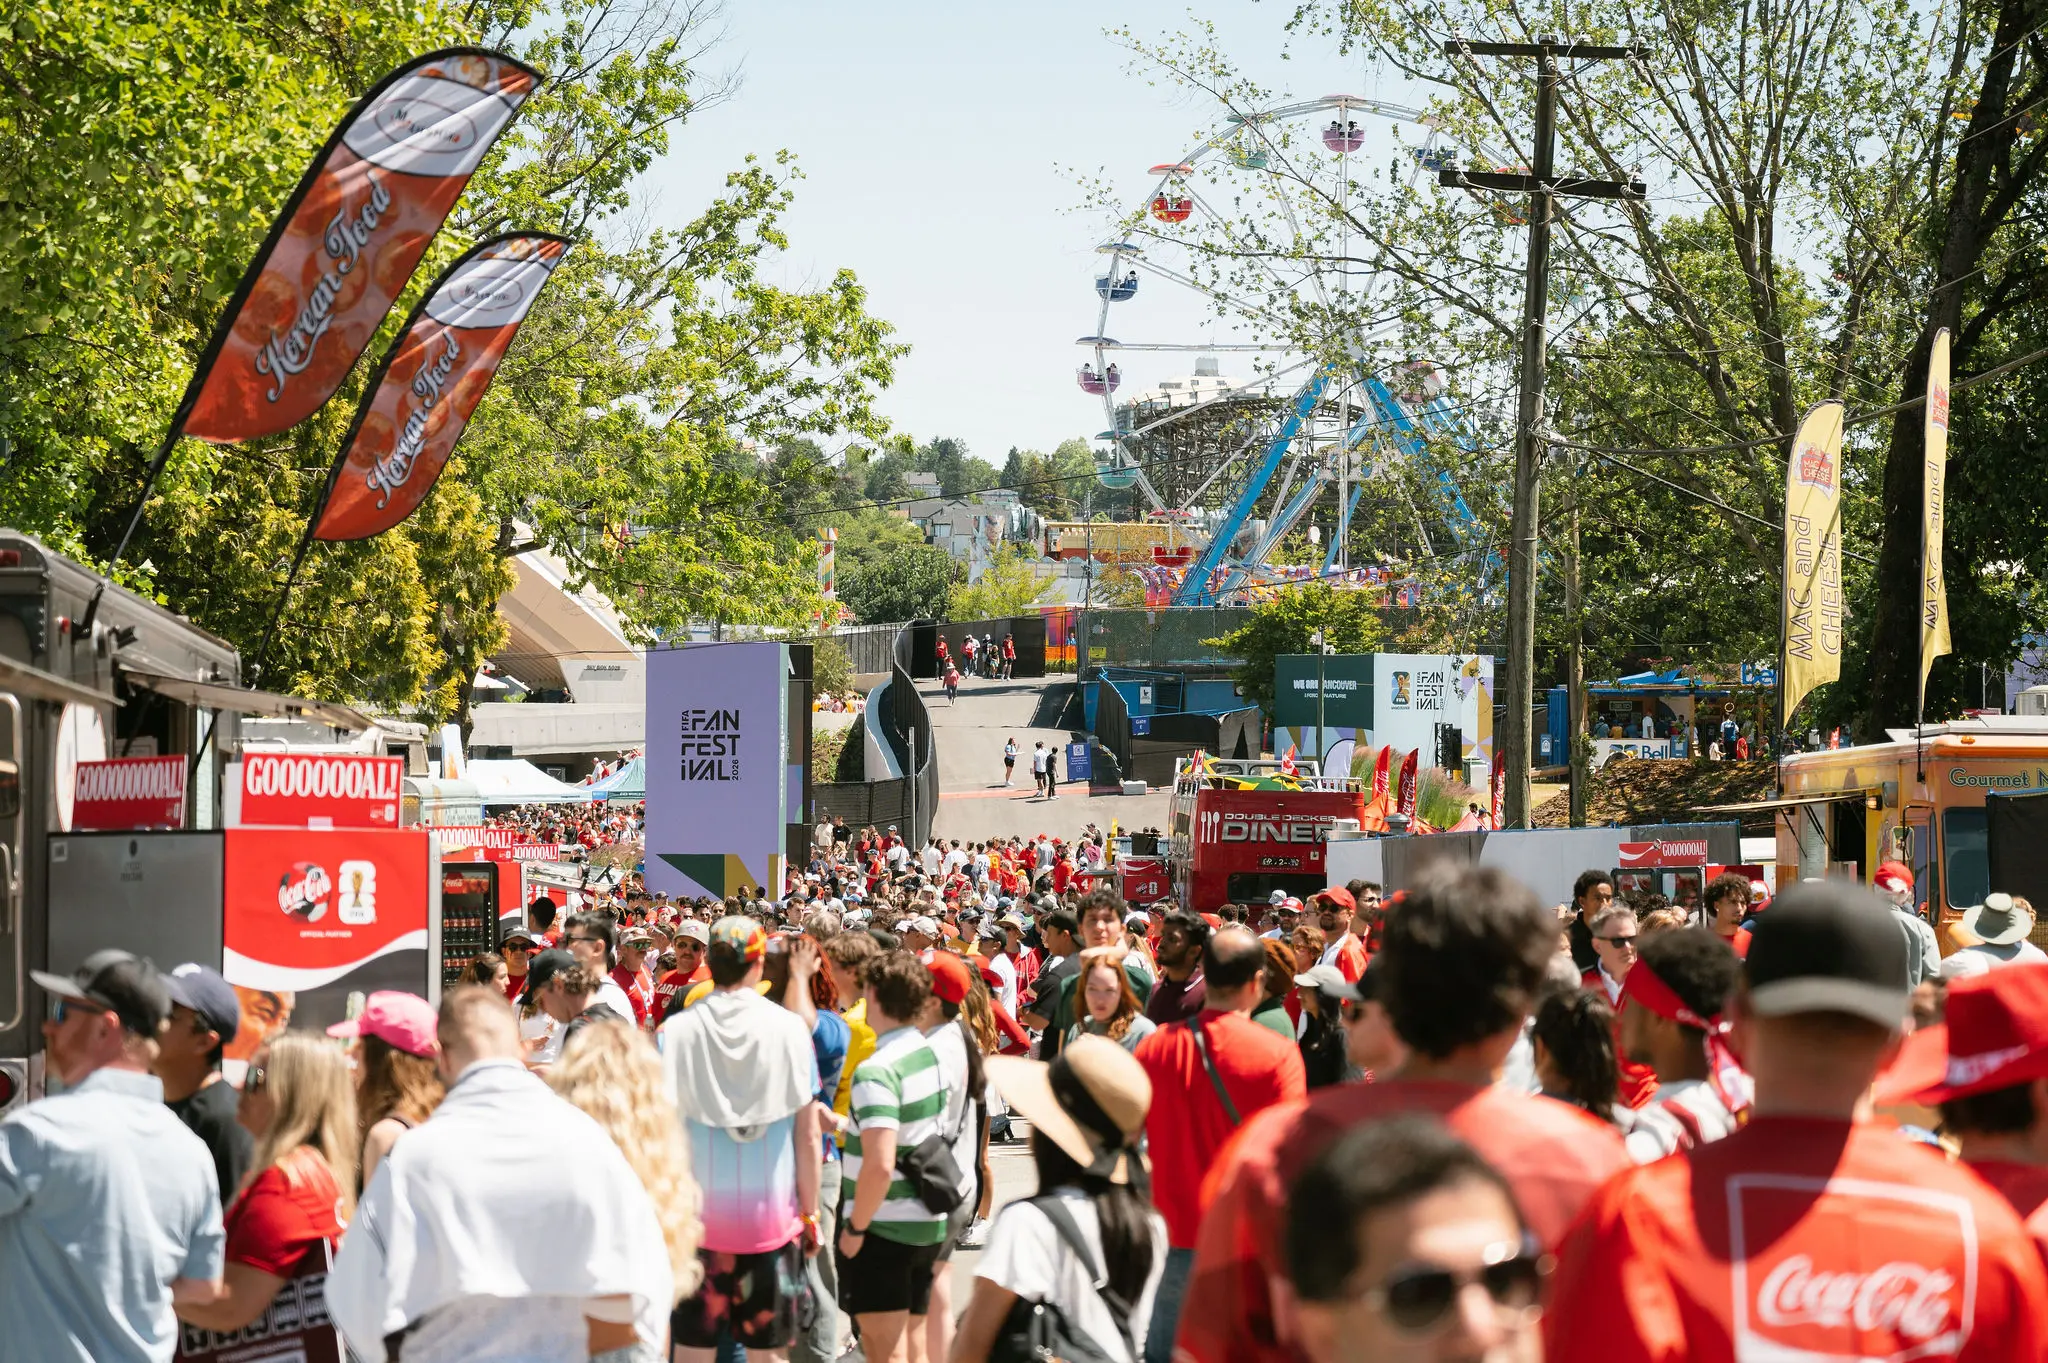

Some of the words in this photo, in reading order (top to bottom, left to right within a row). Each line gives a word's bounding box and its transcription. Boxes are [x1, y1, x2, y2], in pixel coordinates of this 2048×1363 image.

[256, 272, 342, 402] Korean
[325, 169, 391, 274] Food
[367, 408, 428, 510] Korean
[412, 328, 460, 408] Food
[1791, 514, 1812, 577] and
[1819, 529, 1840, 655] CHEESE
[1789, 588, 1812, 661] MAC
[1324, 680, 1357, 690] ANCOUVER
[1421, 672, 1443, 683] FAN
[1417, 685, 1444, 696] FEST
[692, 709, 740, 731] FAN
[681, 734, 741, 756] FEST
[1642, 745, 1668, 760] Bell
[731, 759, 739, 780] 2026
[1949, 767, 2030, 788] Gourmet
[1081, 878, 1089, 890] 4
